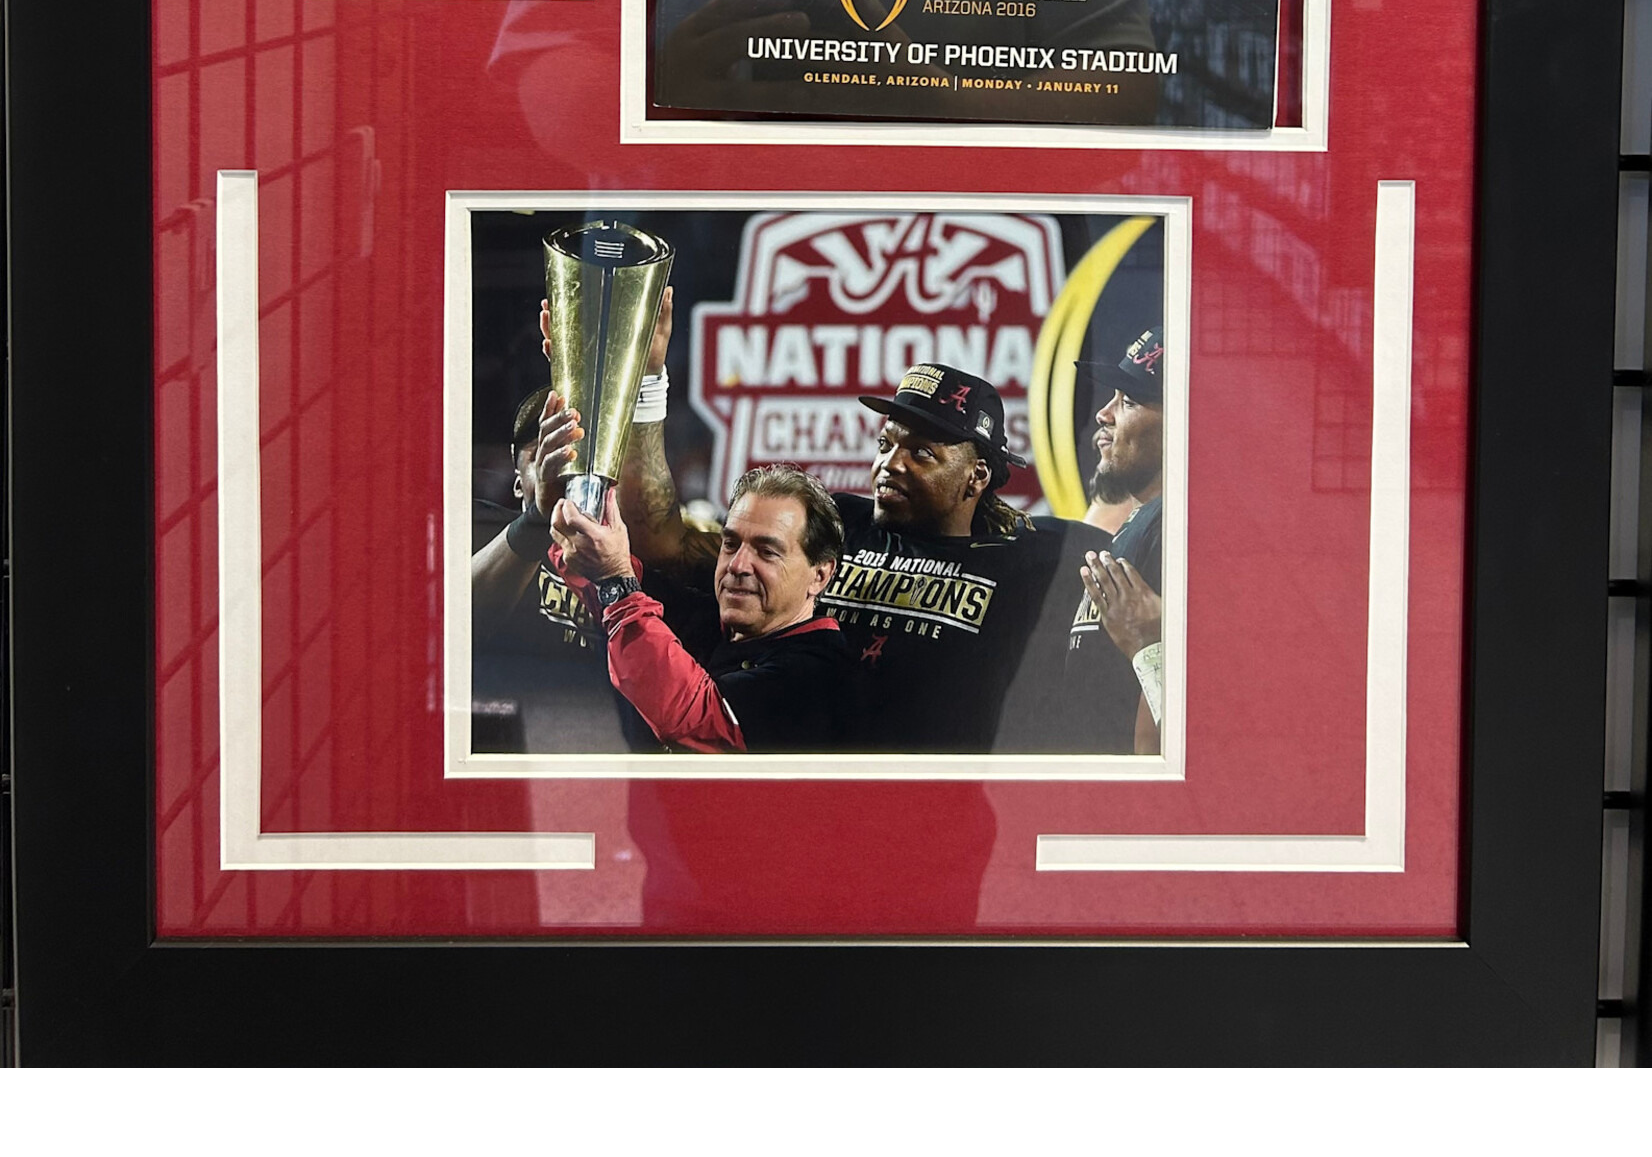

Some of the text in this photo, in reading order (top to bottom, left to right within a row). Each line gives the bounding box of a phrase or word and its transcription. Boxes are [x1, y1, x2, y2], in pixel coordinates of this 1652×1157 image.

[922, 0, 1037, 17] ARIZONA 2016
[748, 37, 1178, 75] UNIVERSITY OF PHOENIX STADIUM
[803, 72, 1119, 94] GLENDALE, ARIZONA MONDAY JANUARY 11
[716, 324, 1036, 388] NATIONA
[853, 548, 963, 578] 2015 NATIONAL
[826, 607, 942, 640] WON AS ONE
